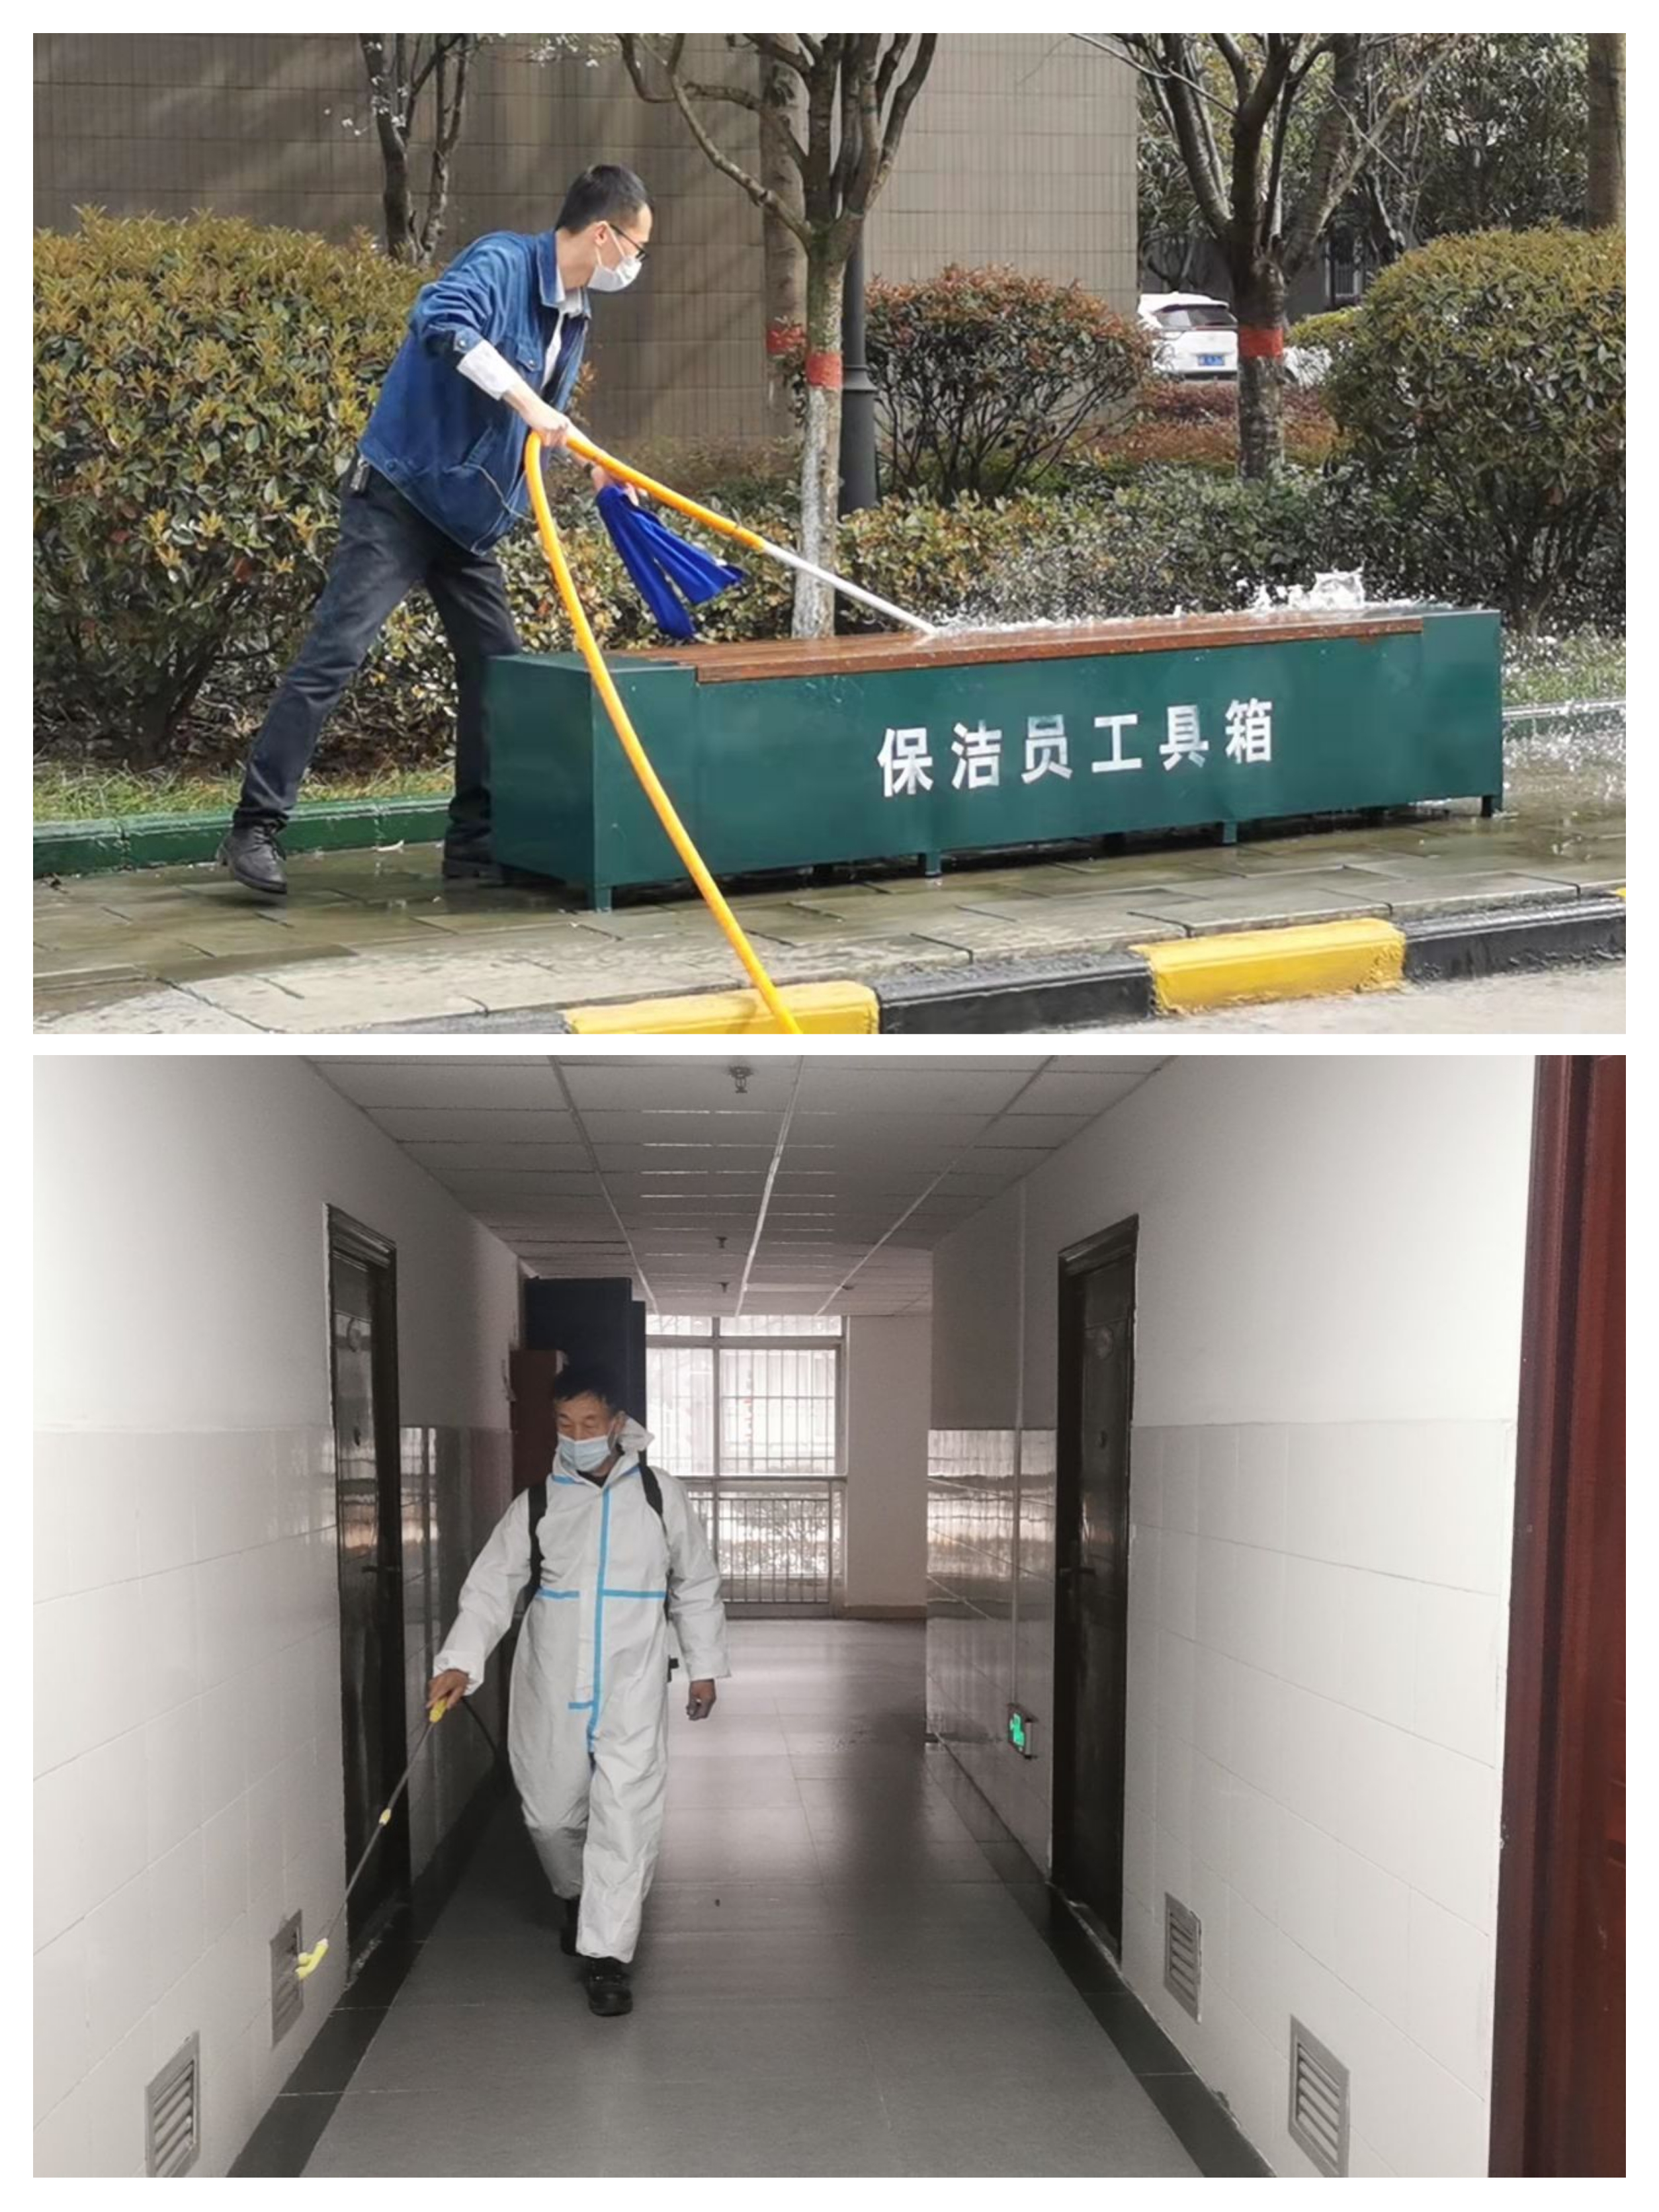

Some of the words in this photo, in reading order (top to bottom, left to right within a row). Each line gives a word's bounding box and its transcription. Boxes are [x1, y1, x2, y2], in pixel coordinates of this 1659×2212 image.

[877, 697, 1273, 798] 保洁员工具箱
